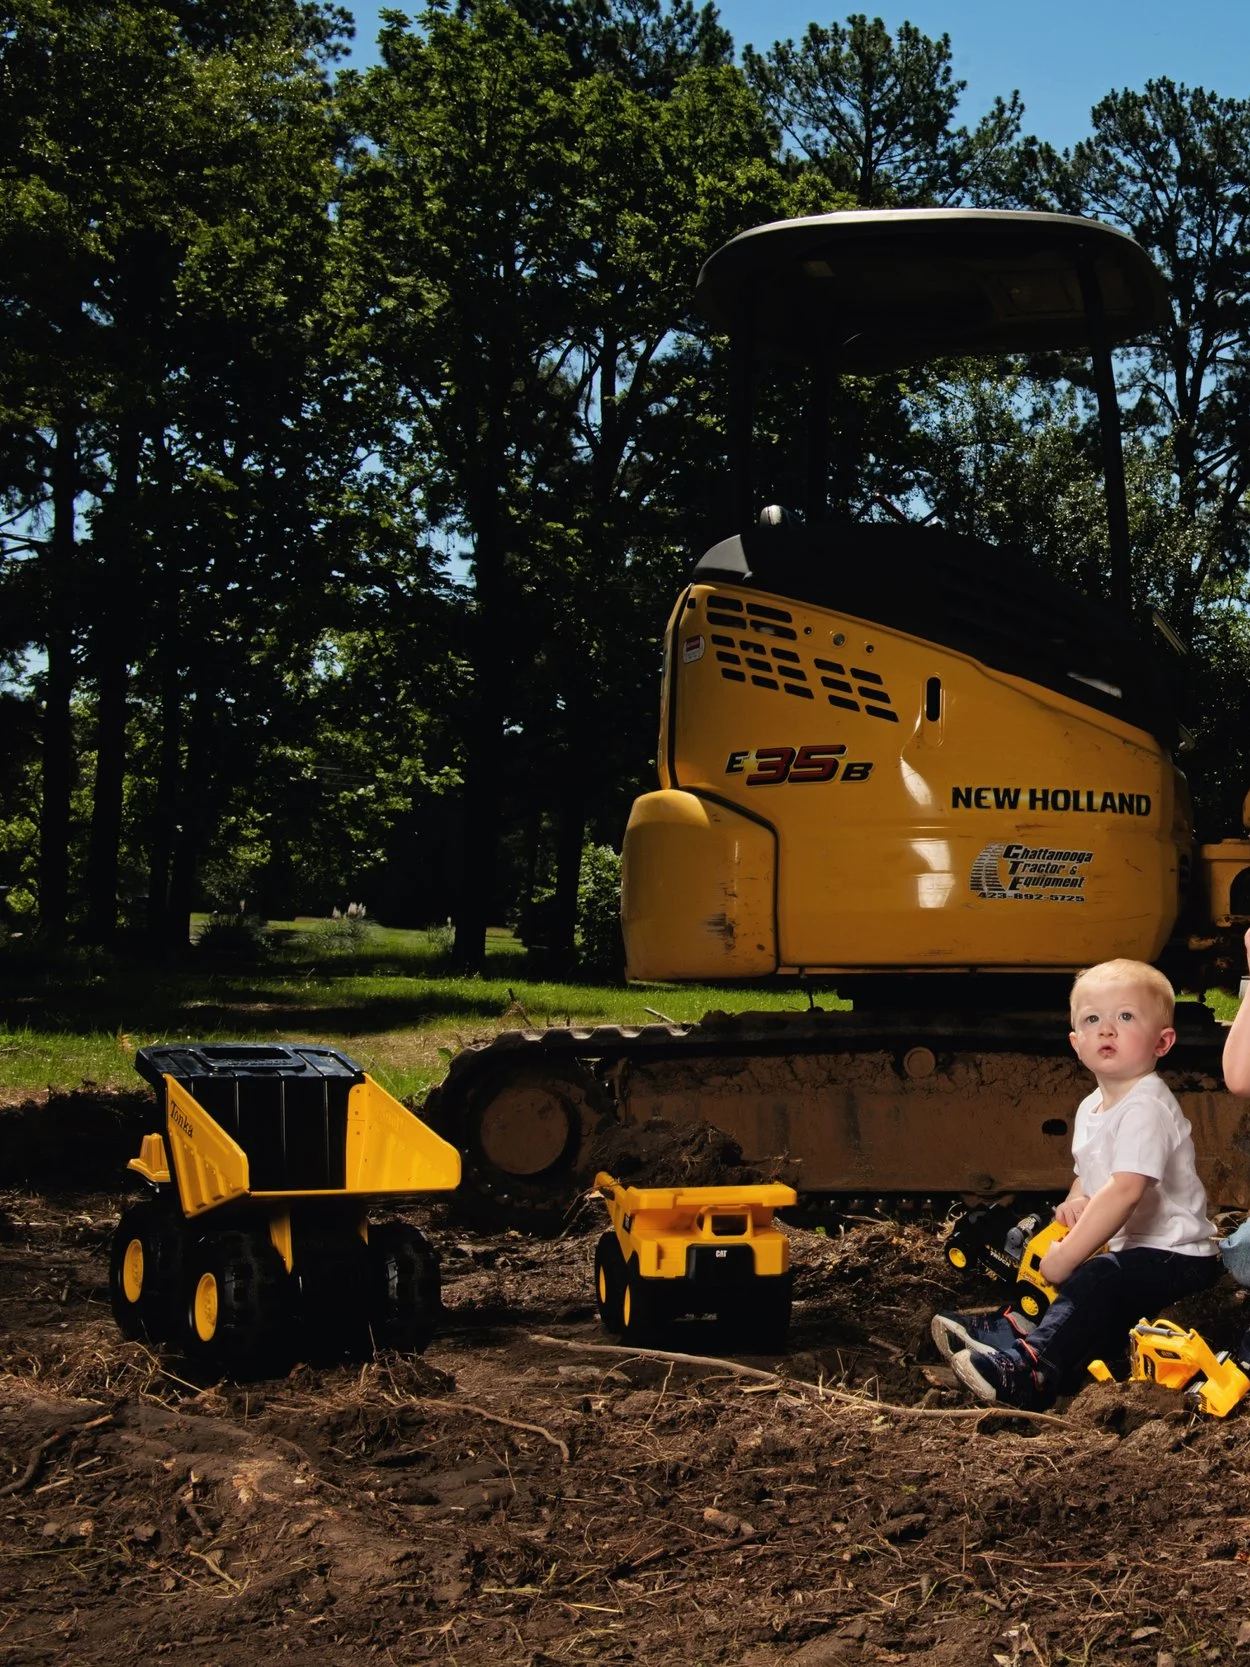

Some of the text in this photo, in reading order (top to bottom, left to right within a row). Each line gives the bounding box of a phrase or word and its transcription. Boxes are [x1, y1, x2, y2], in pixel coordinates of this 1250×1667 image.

[952, 786, 1152, 817] NEW HOLLAND
[1003, 844, 1094, 863] Chattanooga
[1008, 860, 1078, 875] Tractor &
[1008, 876, 1085, 891] Equipment
[978, 892, 1085, 902] 423-892-5725
[170, 1100, 194, 1138] Tonka
[715, 1250, 728, 1258] CAT
[990, 1250, 1011, 1267] TRUCK
